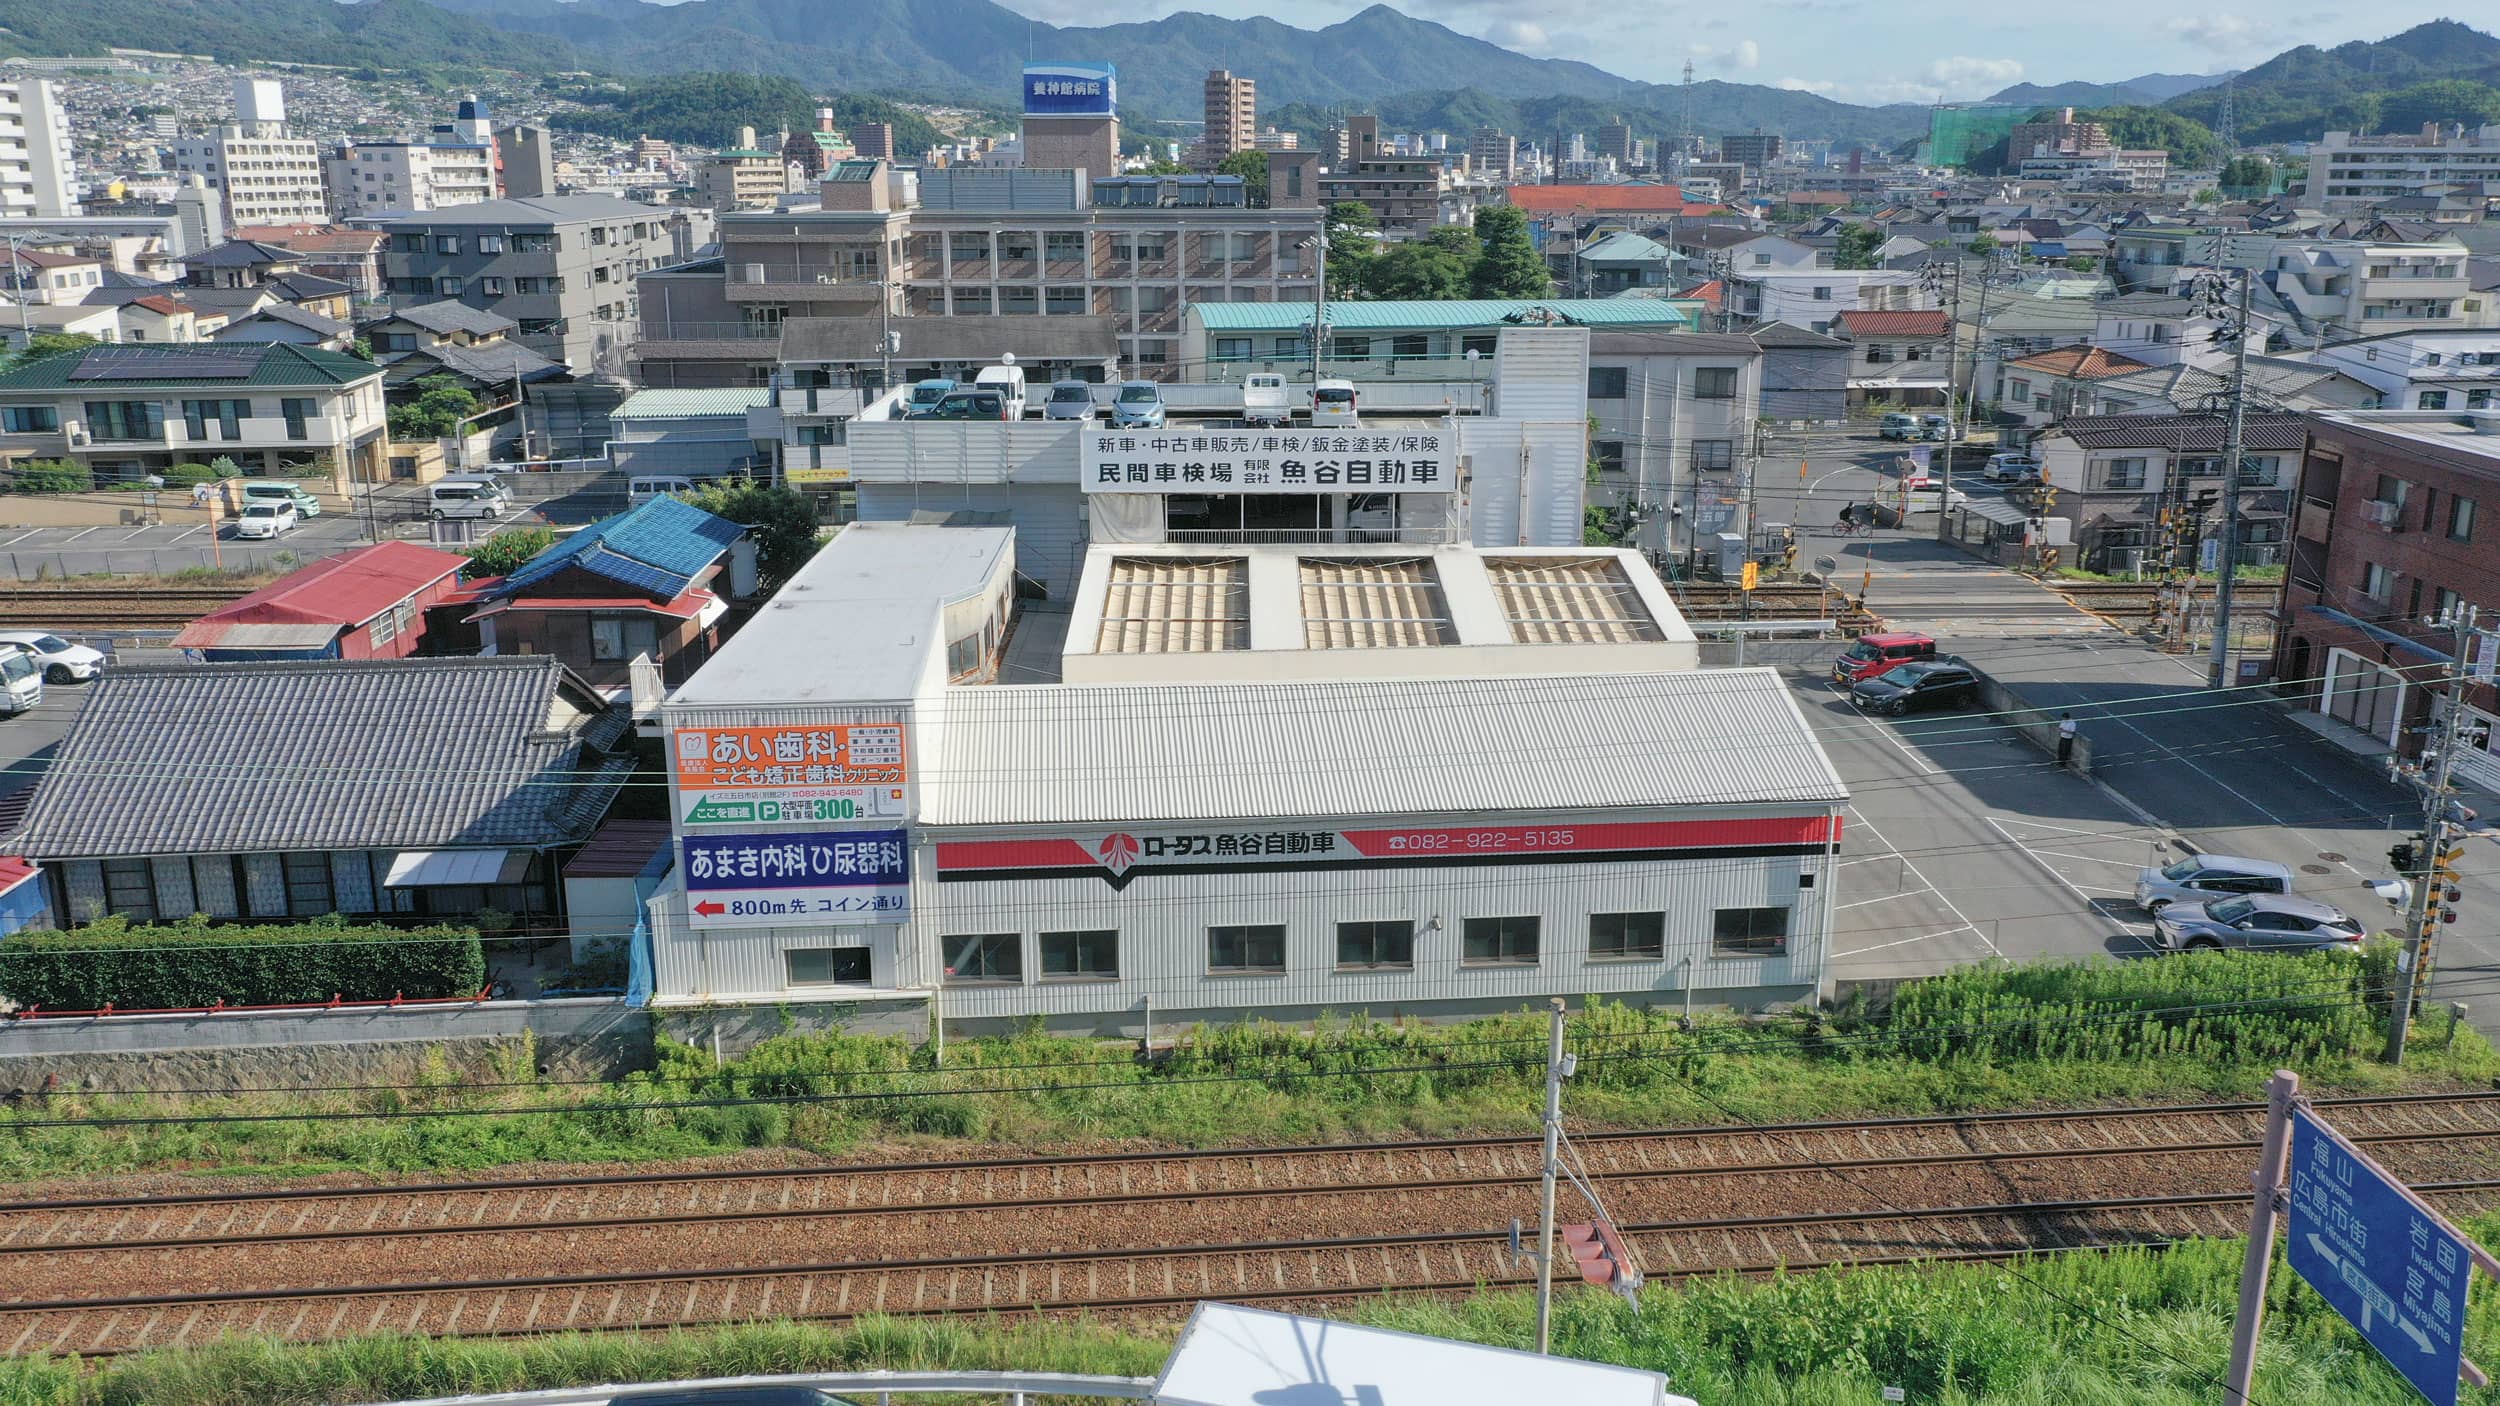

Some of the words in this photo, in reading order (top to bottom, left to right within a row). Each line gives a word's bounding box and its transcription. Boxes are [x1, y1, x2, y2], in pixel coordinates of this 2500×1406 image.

[1032, 81, 1101, 96] 養神館病院
[1097, 462, 1233, 484] 民間車検場
[1243, 473, 1270, 484] 会社
[1279, 459, 1439, 485] 魚谷自動車
[1243, 459, 1270, 471] 有限
[696, 806, 751, 819] ここを直進
[782, 810, 813, 821] 駐車場
[781, 800, 813, 811] 大型平面
[1408, 830, 1574, 849] 082-922-5135
[818, 895, 903, 913] コイン通り
[2310, 1161, 2353, 1207] Fukuyama
[2313, 1136, 2353, 1188] 福山
[2293, 1193, 2321, 1226] Central
[2325, 1221, 2366, 1267] Hiroshima
[2295, 1170, 2367, 1249] 広島市街
[2409, 1215, 2457, 1274] 岩国
[2411, 1246, 2451, 1290] Iwakuni
[2406, 1265, 2452, 1325] 宮島
[2402, 1291, 2452, 1345] Miyajima
